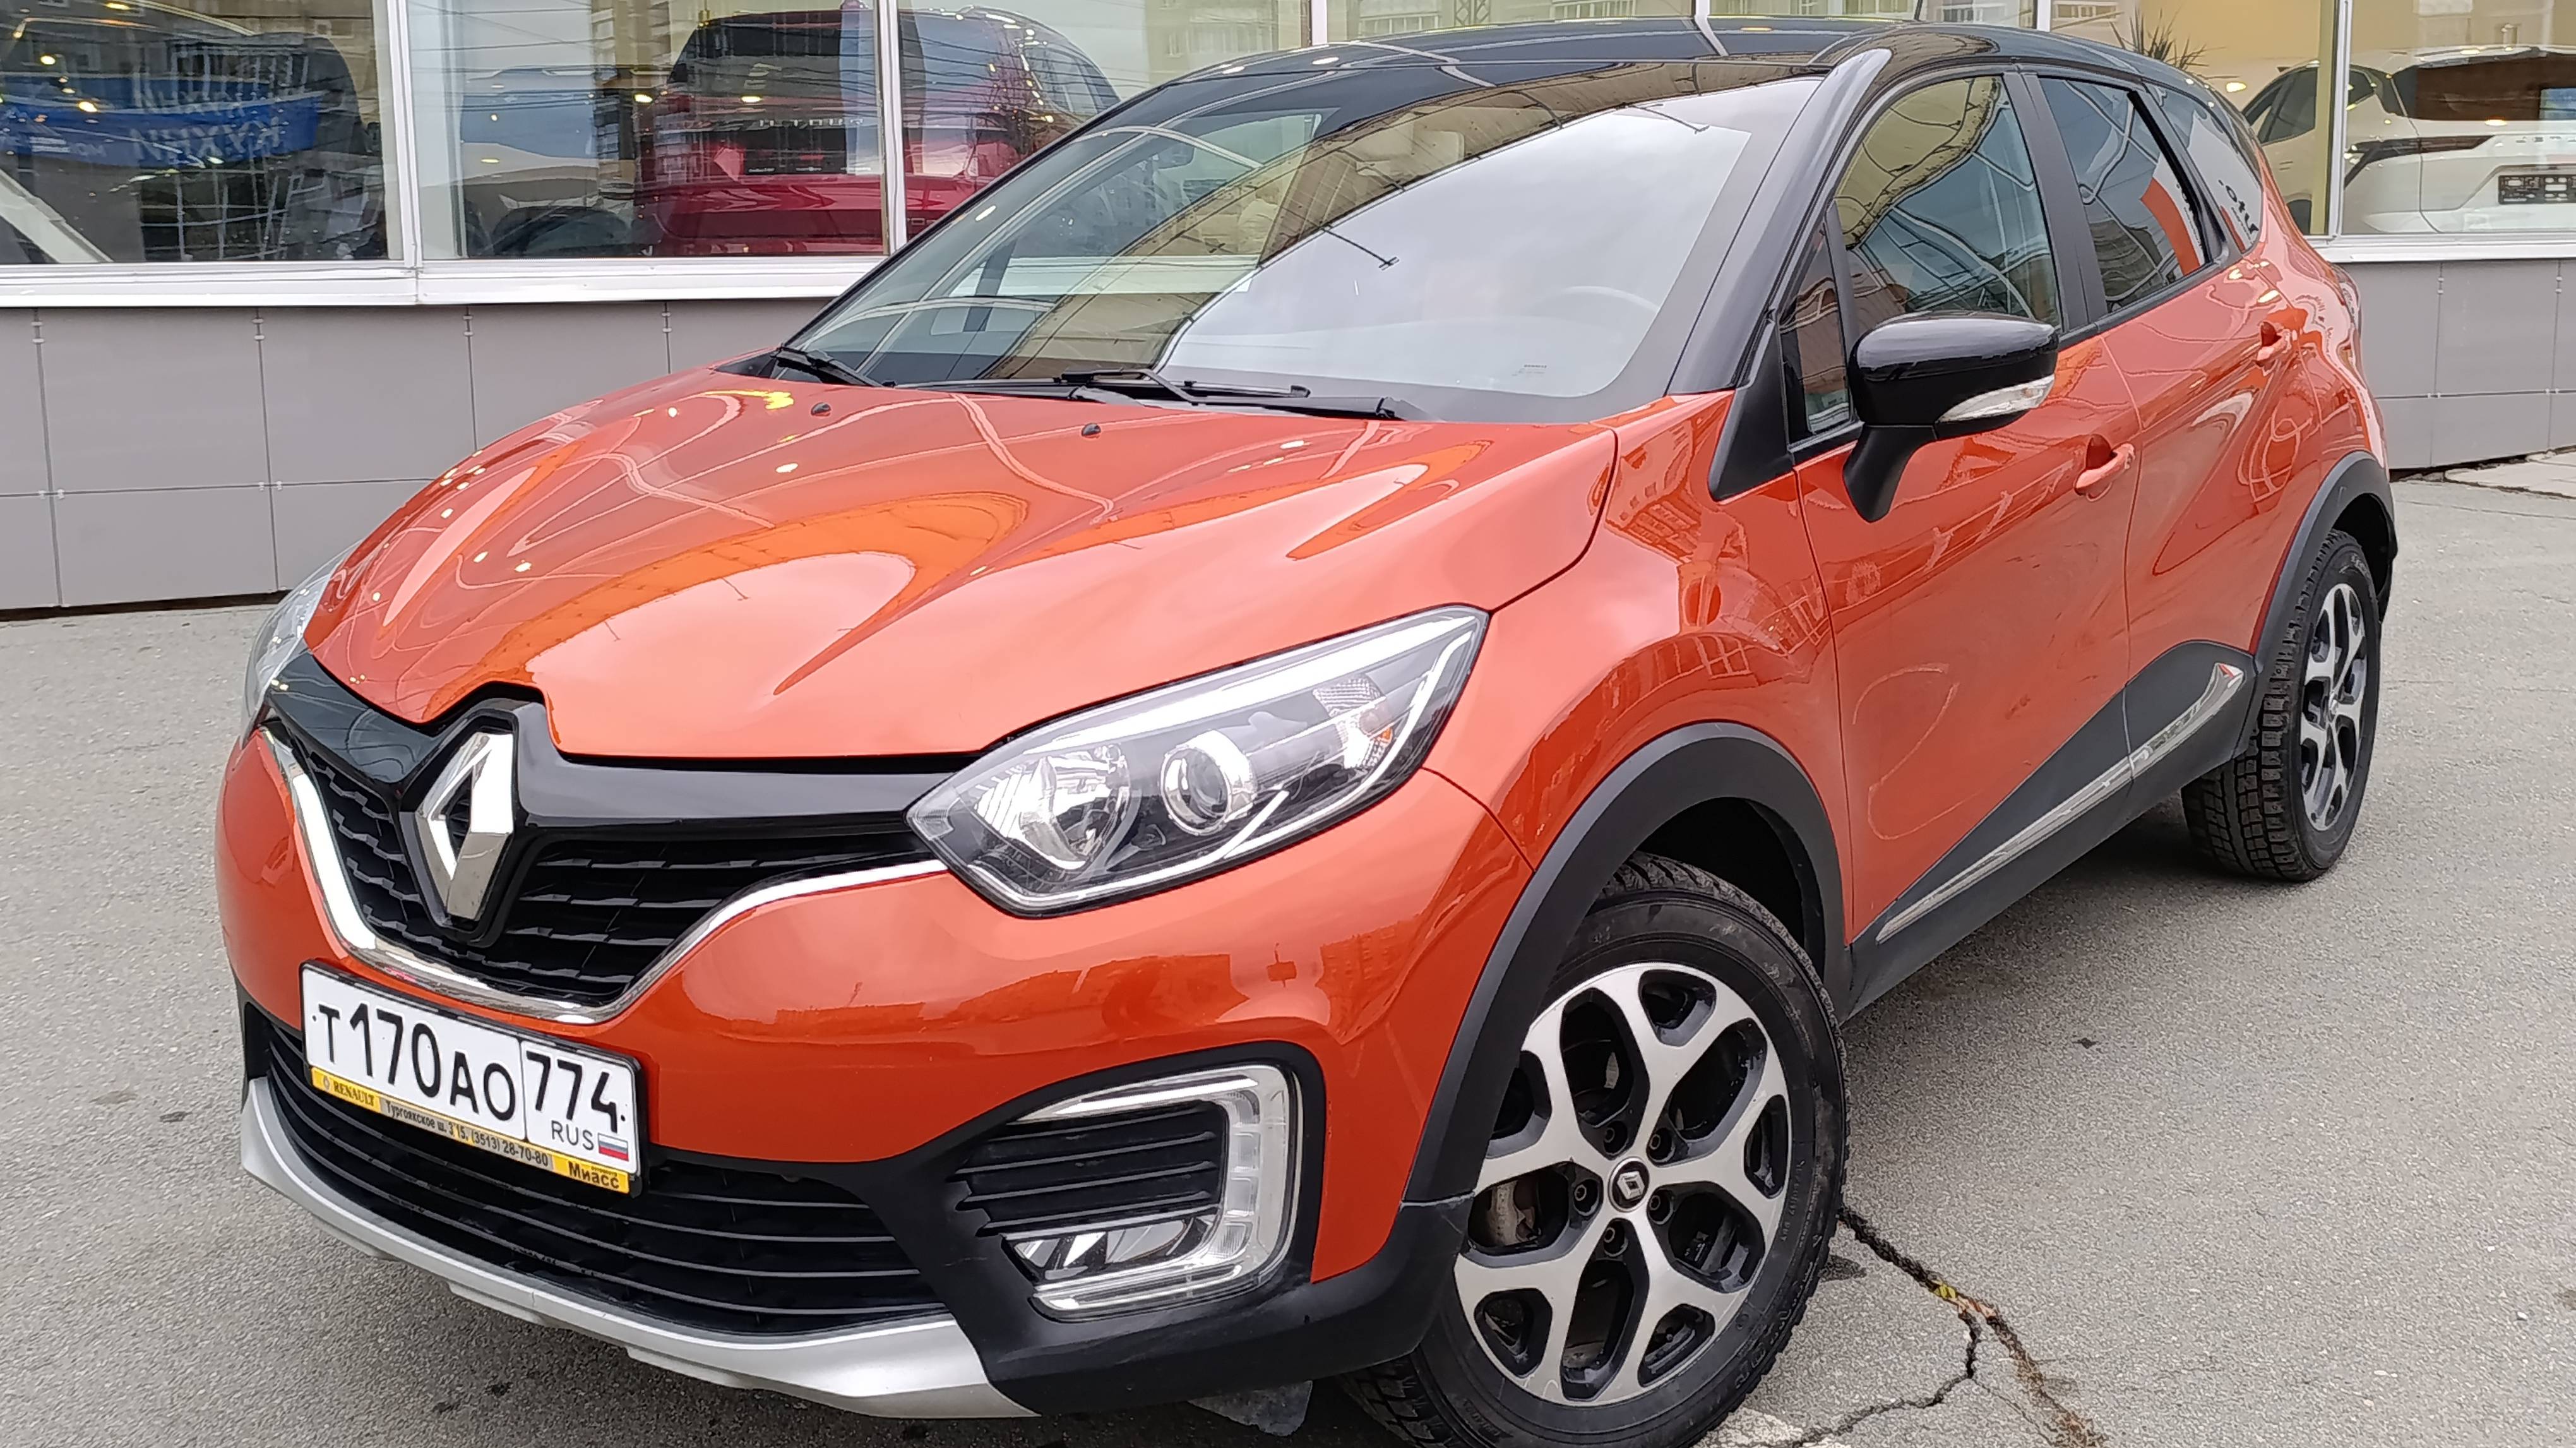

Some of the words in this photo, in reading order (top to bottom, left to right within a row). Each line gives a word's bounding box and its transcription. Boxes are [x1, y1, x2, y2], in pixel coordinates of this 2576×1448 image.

[333, 1080, 375, 1107] RENAULT
[551, 1120, 595, 1151] RUS
[503, 1139, 549, 1167] 28-70-80
[568, 1160, 619, 1188] Миасс
